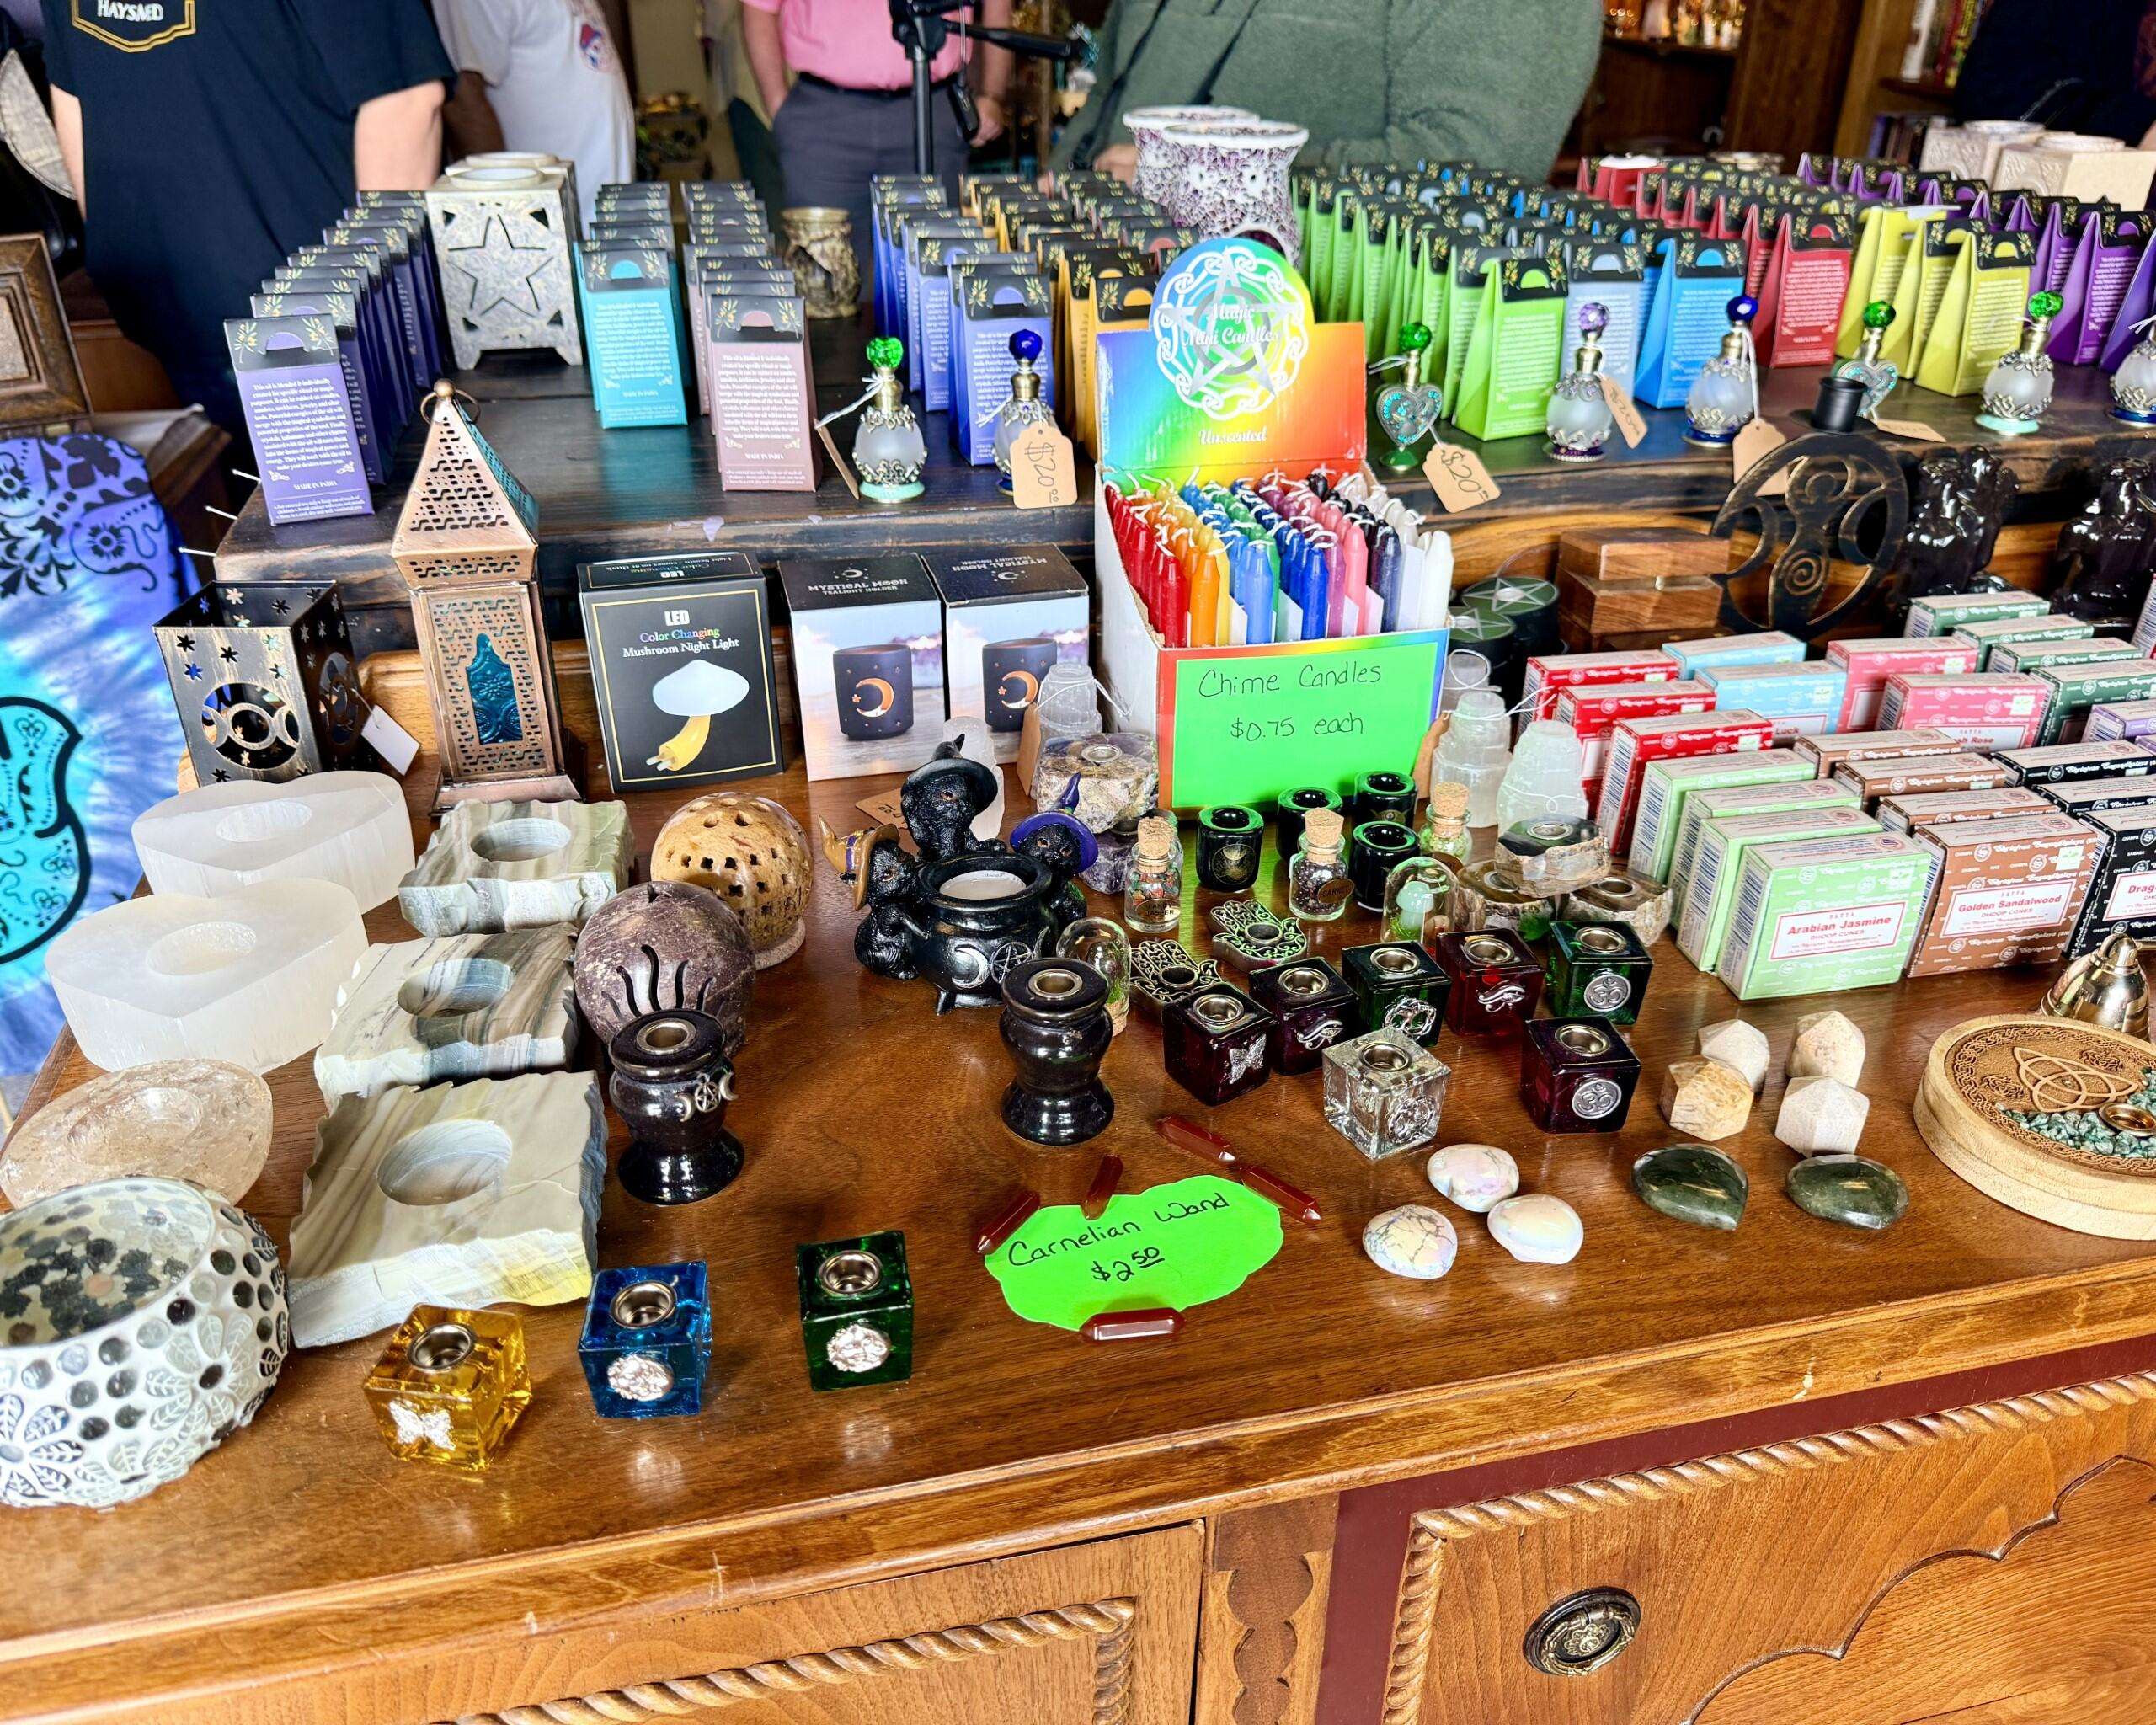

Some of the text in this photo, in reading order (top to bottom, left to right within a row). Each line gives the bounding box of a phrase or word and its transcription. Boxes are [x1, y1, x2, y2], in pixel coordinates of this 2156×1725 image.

[1207, 303, 1255, 324] Magic
[1184, 325, 1278, 346] Mini Candles
[1198, 426, 1267, 445] Unscented
[990, 558, 1047, 568] MYSTICAL
[808, 579, 908, 592] MYSTICAL MOON
[664, 610, 690, 627] LED
[640, 628, 721, 643] Color Changing
[622, 638, 739, 658] Mushroom Night Light
[1199, 661, 1381, 697] Chime Candles
[1230, 712, 1363, 741] $0.75 each
[2128, 884, 2156, 894] Drag
[1959, 895, 2062, 912] Golden Sandalwood
[1788, 916, 1892, 935] Arabian Jasmine
[1009, 1192, 1230, 1266] Carnelian Wand
